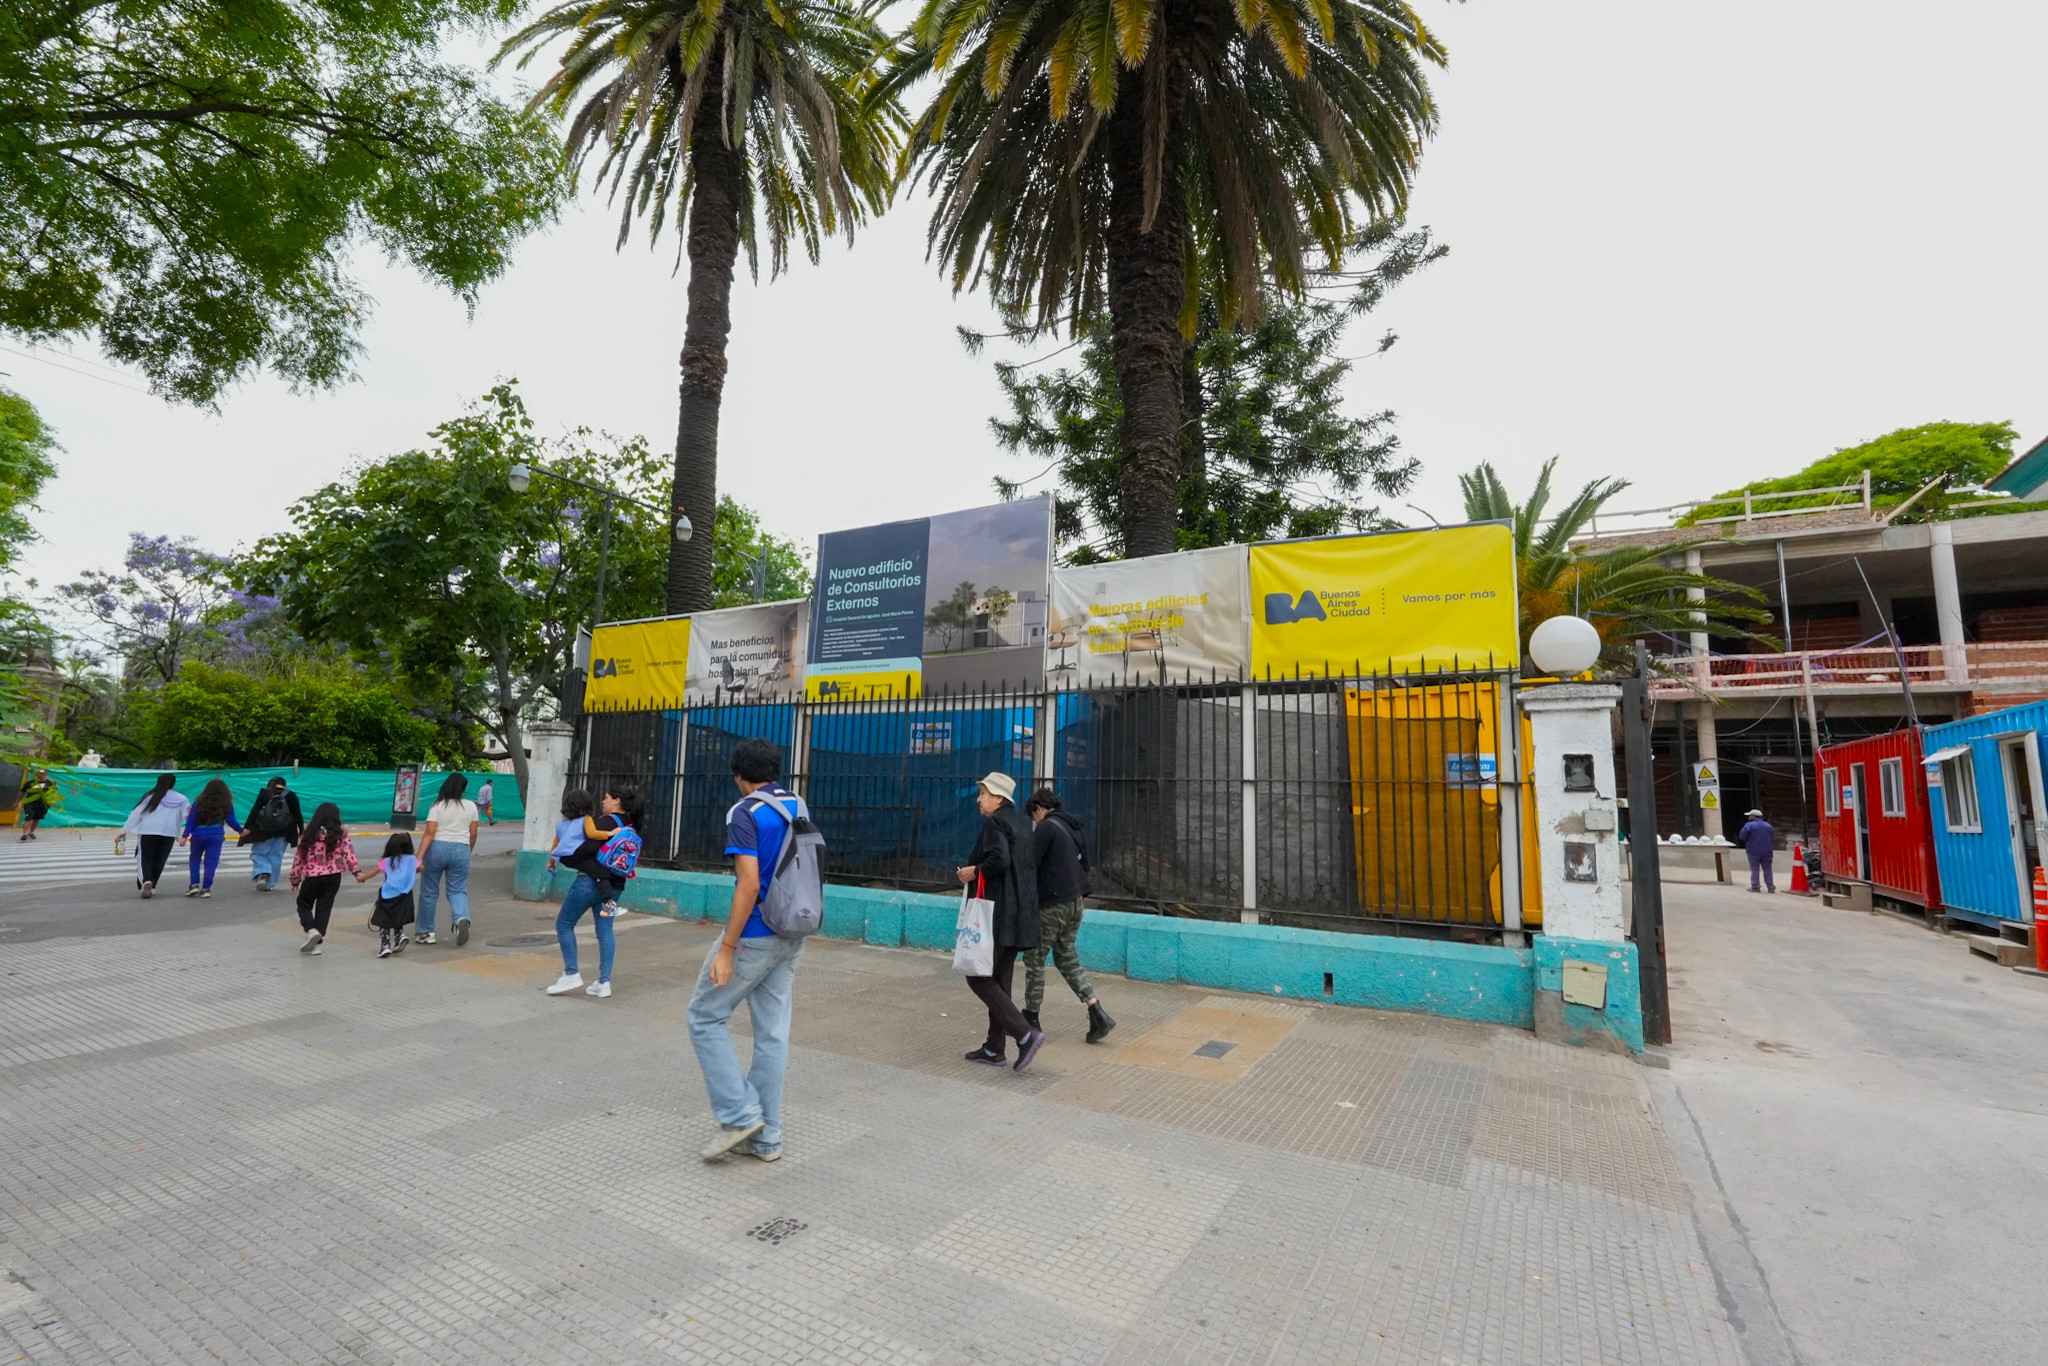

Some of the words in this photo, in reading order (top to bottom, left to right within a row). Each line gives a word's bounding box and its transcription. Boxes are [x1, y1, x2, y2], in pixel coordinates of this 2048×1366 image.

[829, 567, 865, 580] Nuevo
[868, 558, 913, 576] edificio
[827, 582, 842, 596] de
[844, 574, 921, 594] Consultorios
[826, 596, 878, 611] Externos
[1320, 590, 1361, 600] Buenos
[1327, 598, 1357, 608] Aires
[1402, 593, 1441, 604] Vamos
[1444, 592, 1467, 604] por
[1470, 588, 1497, 600] más
[1088, 601, 1142, 617] Mejoras
[1146, 592, 1209, 609] edilicias
[1264, 590, 1328, 625] BA
[1330, 606, 1371, 618] Ciudad
[1088, 623, 1105, 635] en
[1107, 617, 1164, 634] Centros
[1165, 614, 1185, 628] de
[710, 640, 728, 650] Mas
[730, 635, 775, 648] beneficios
[1088, 639, 1127, 654] Salud
[710, 653, 729, 666] para
[730, 652, 737, 662] la
[739, 648, 790, 661] comunidad
[593, 657, 617, 679] BA
